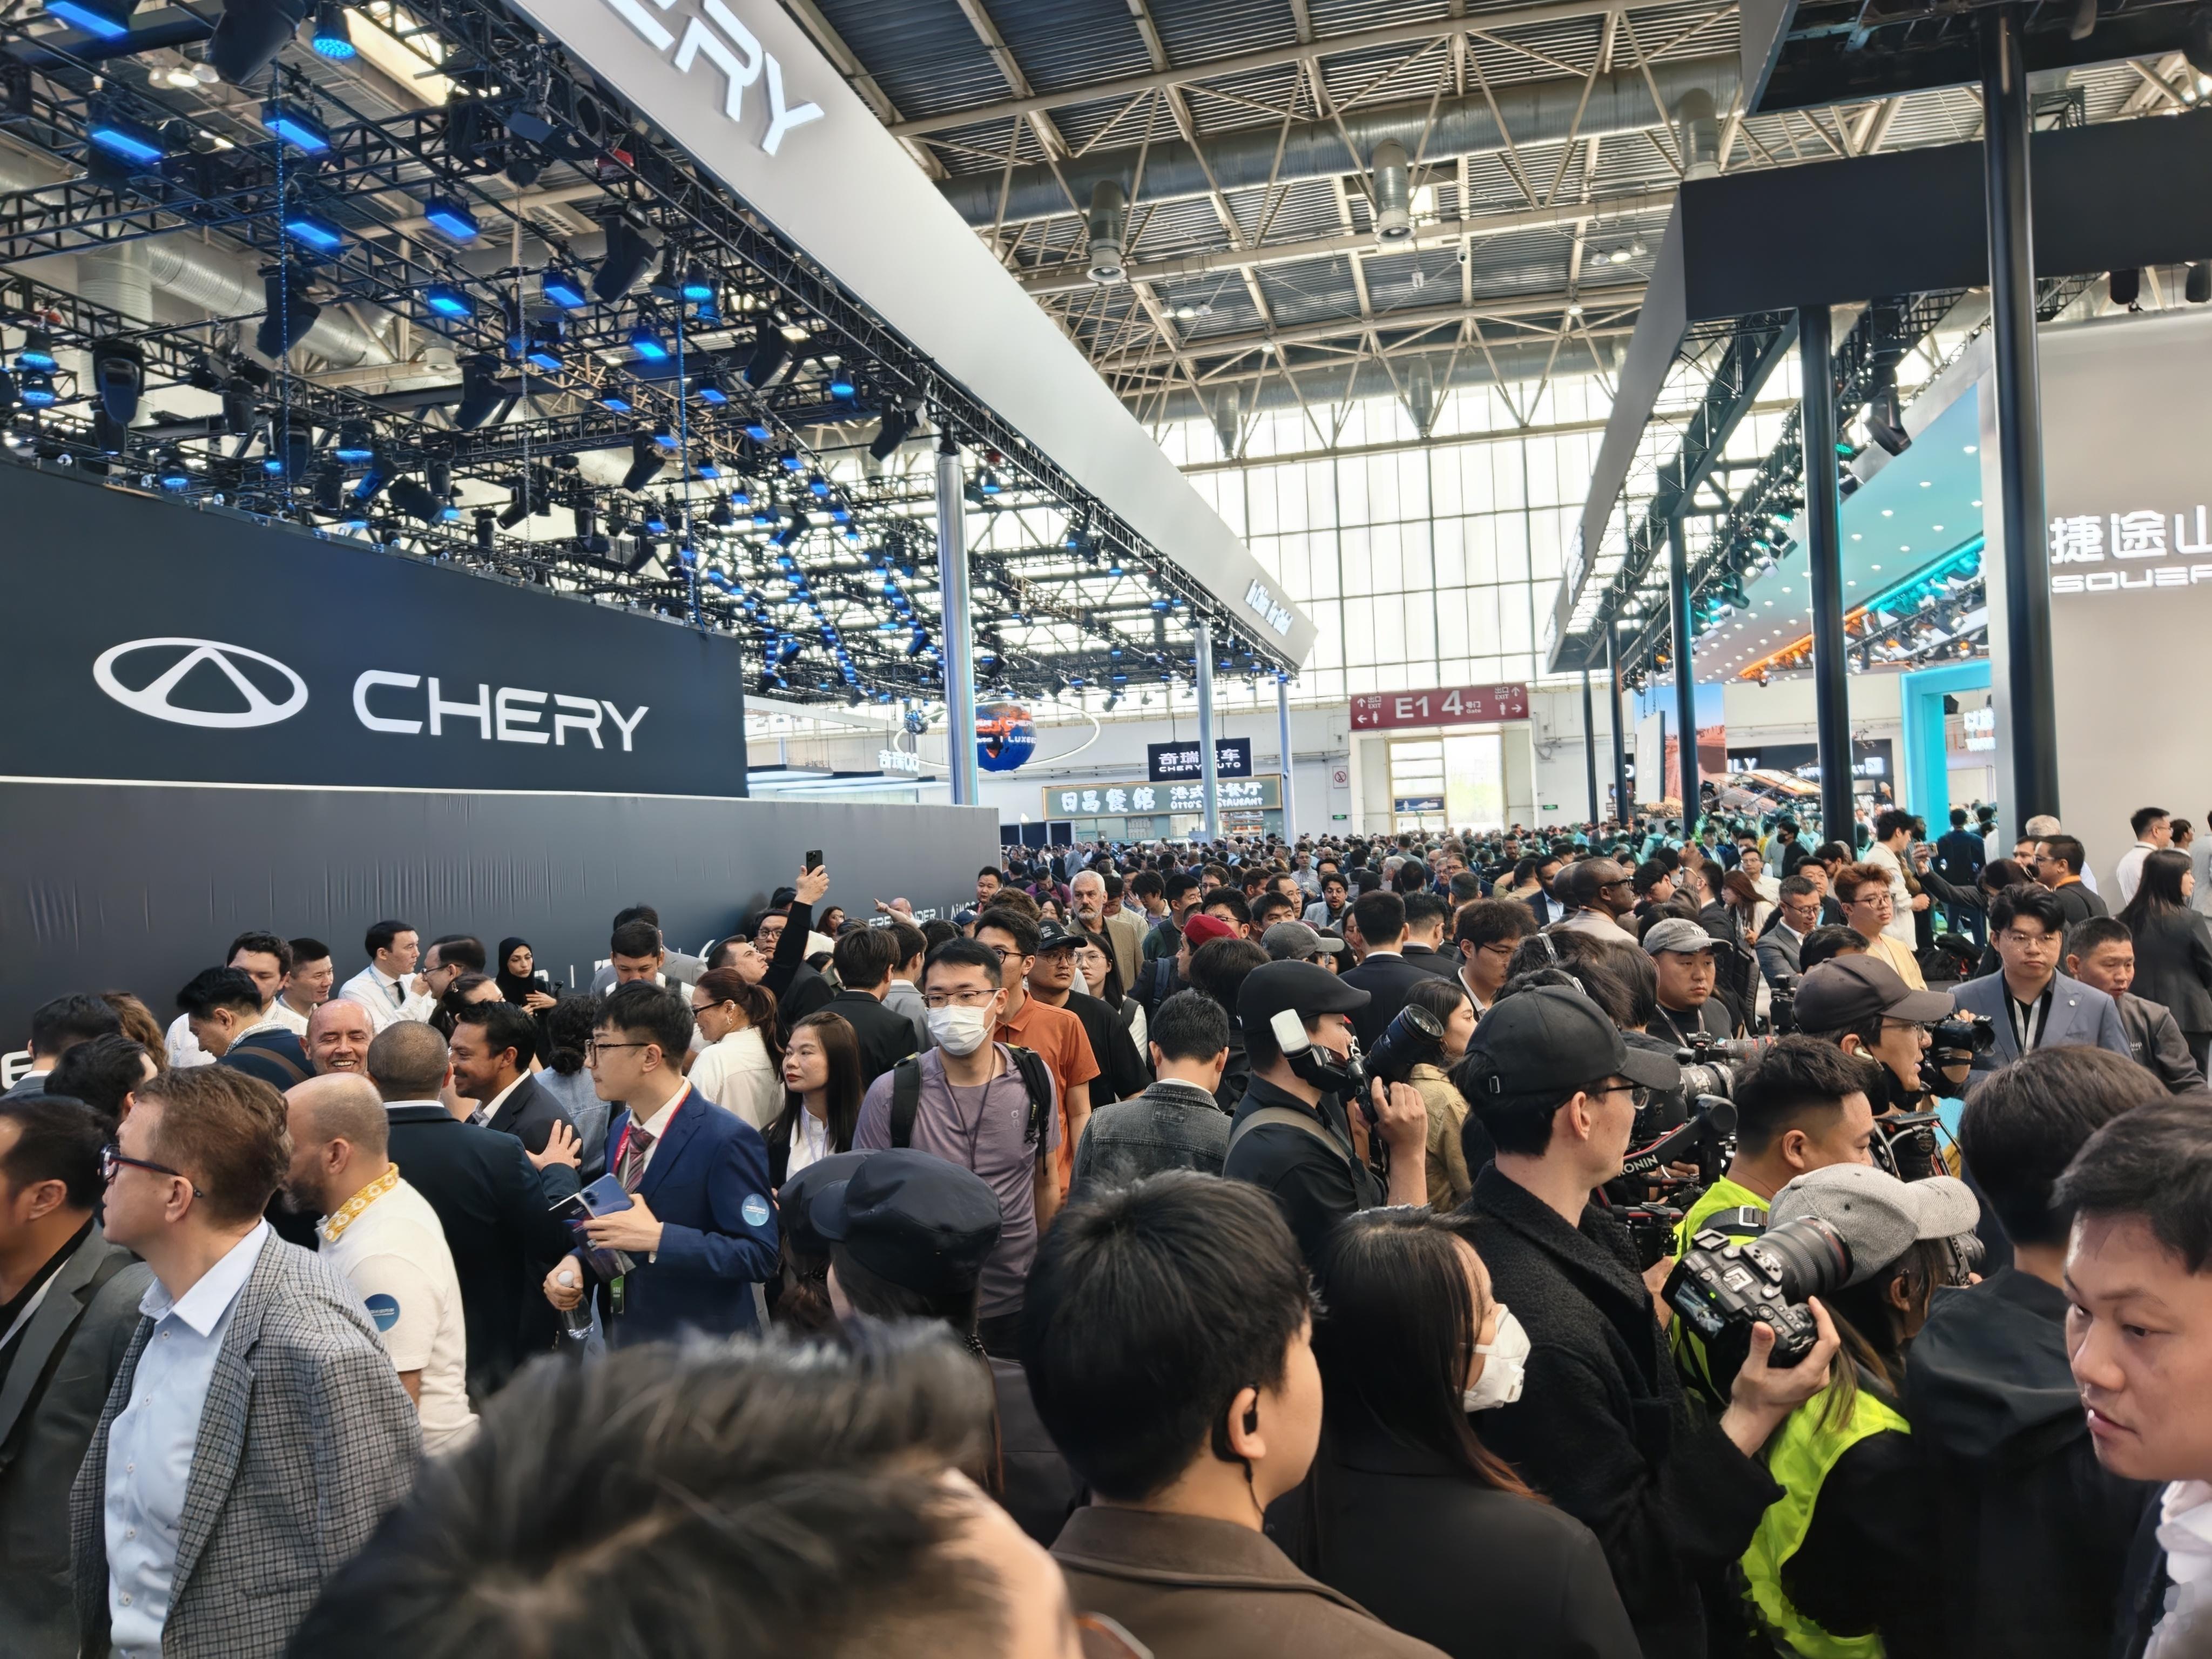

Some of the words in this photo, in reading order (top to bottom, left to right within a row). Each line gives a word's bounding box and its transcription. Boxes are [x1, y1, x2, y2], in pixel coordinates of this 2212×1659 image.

[353, 670, 650, 752] CHERY
[1395, 696, 1429, 719] E1
[1441, 690, 1464, 716] 4
[1158, 748, 1240, 765] 奇瑞车
[1158, 763, 1202, 773] CHERY
[1061, 786, 1156, 813] 日昌餐馆
[1217, 797, 1264, 808] STAURANT
[1618, 1154, 1659, 1176] ONIN
